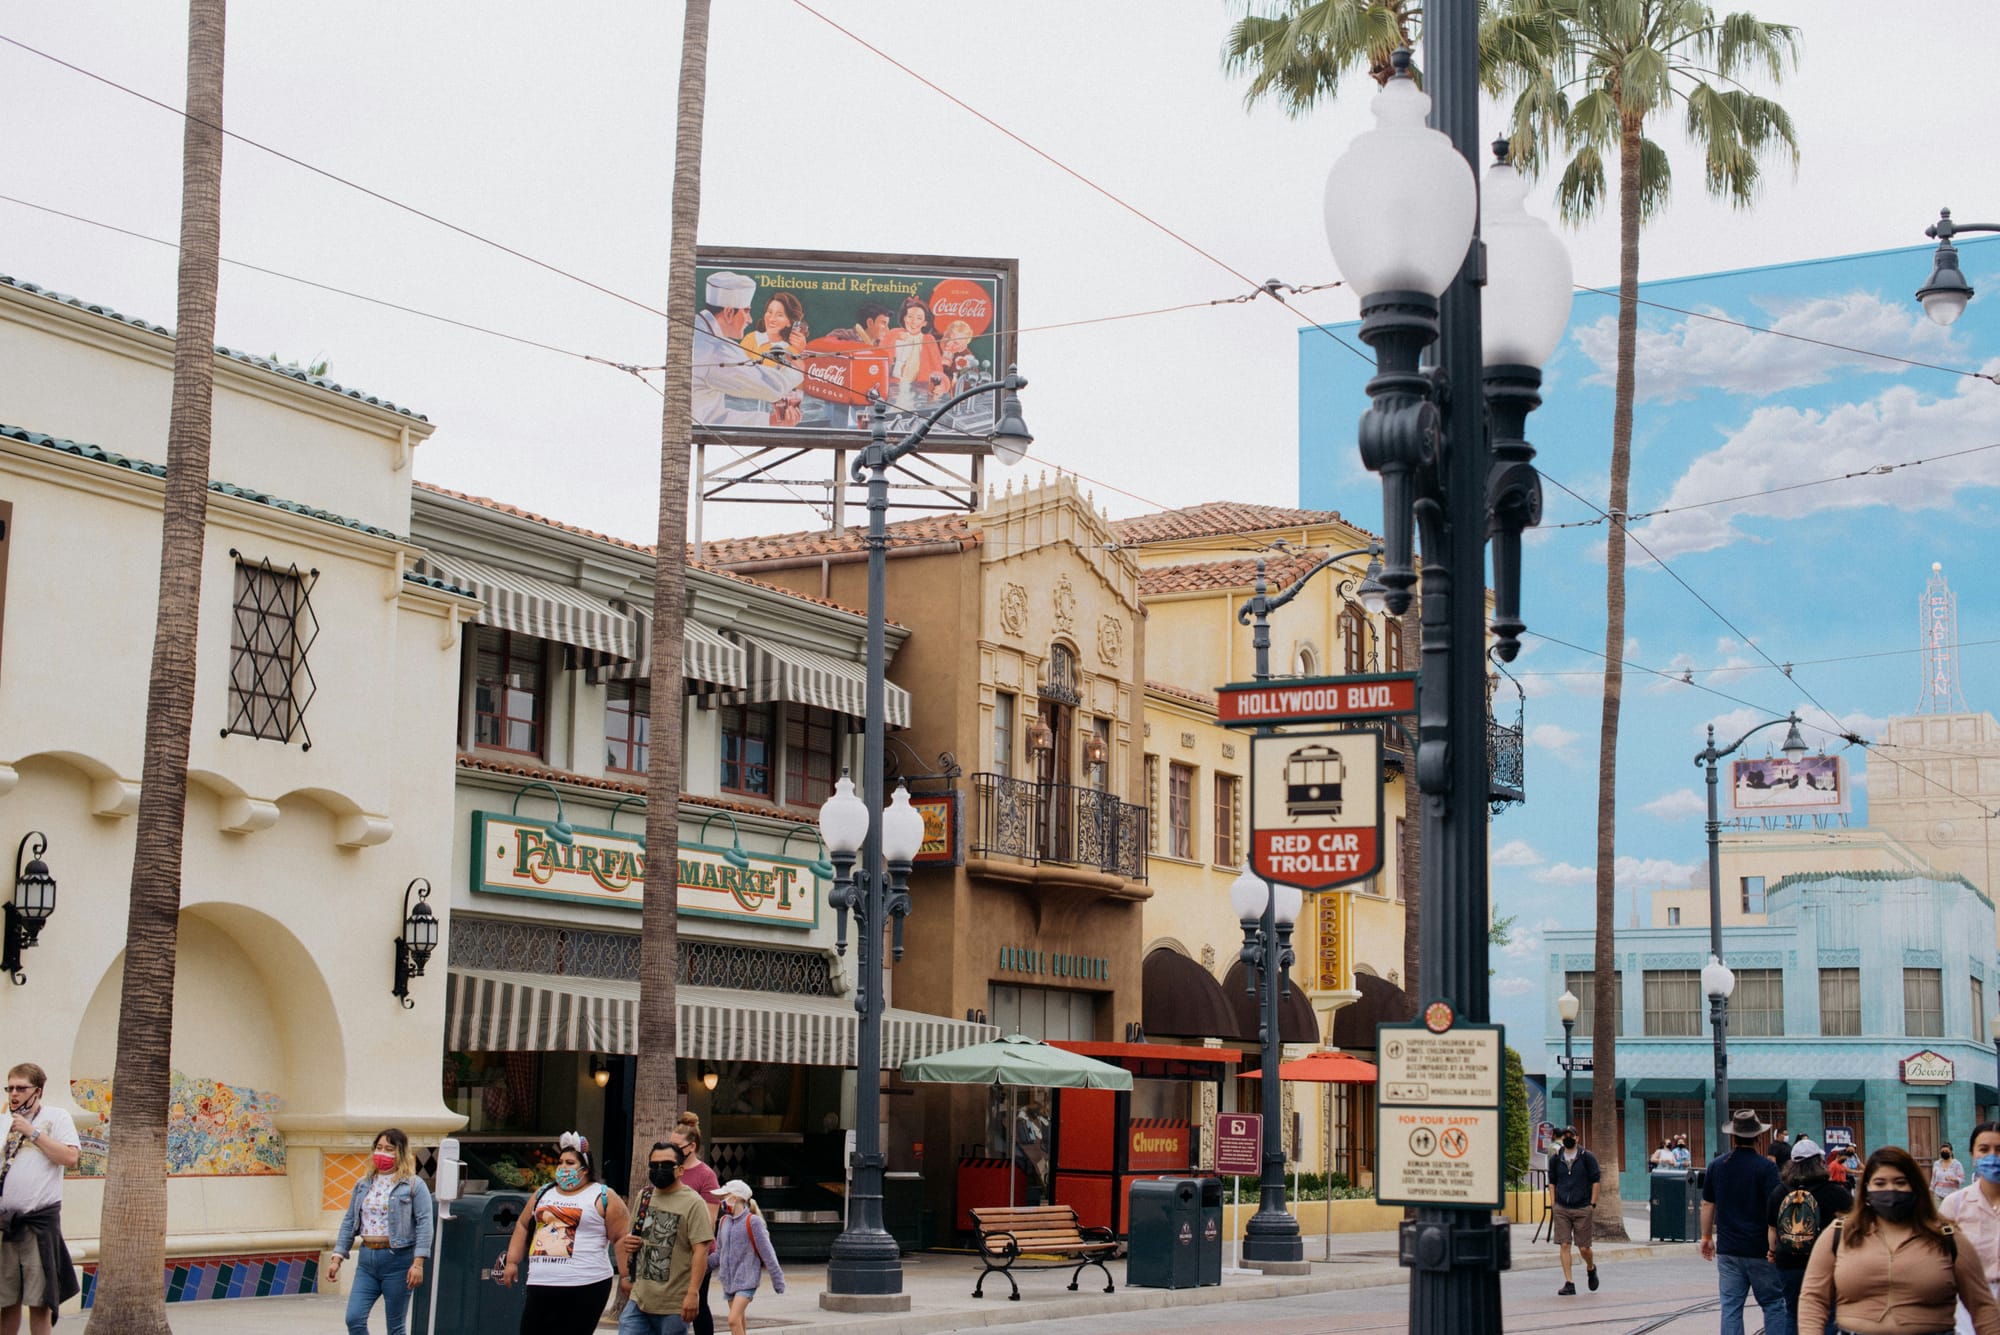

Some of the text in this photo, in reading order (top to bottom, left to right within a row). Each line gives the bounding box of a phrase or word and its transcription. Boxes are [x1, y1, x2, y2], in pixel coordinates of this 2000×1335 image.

[821, 278, 846, 291] and
[1238, 686, 1394, 715] HOLLYWOOD BLVD.
[1271, 834, 1359, 853] RED CAR
[1267, 854, 1360, 873] TROLLEY
[676, 859, 797, 912] MARKET
[1320, 896, 1337, 987] CARPETS
[1000, 945, 1109, 981] ARGYLE BUILDING
[1907, 1063, 1951, 1078] Beverly
[1398, 1115, 1479, 1126] FOR YOUR SAFETY
[1133, 1131, 1178, 1152] Churros
